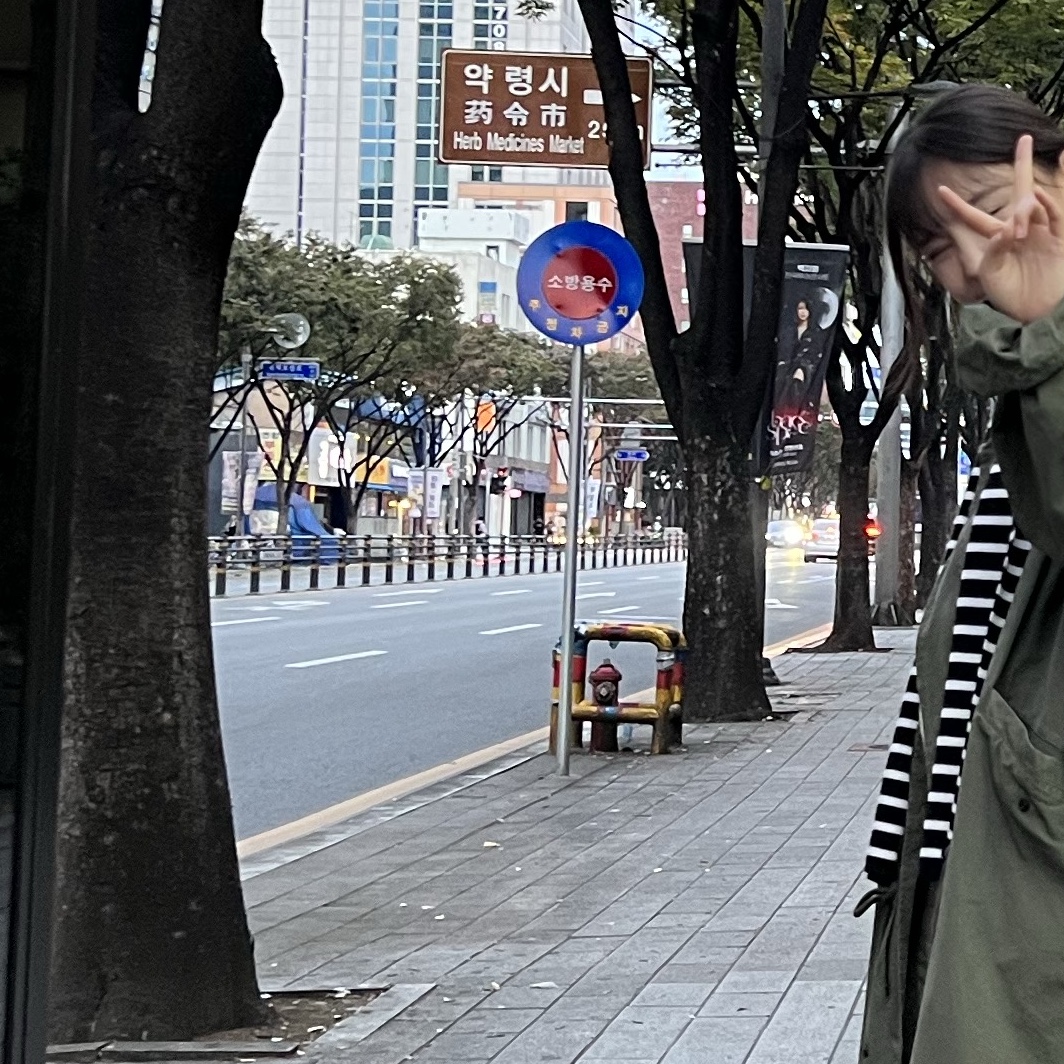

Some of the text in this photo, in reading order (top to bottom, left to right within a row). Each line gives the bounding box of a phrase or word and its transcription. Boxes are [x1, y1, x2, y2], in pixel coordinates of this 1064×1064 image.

[463, 62, 568, 98] 약령시
[453, 131, 585, 154] Herb Medicines Market
[546, 274, 614, 293] 소방용수
